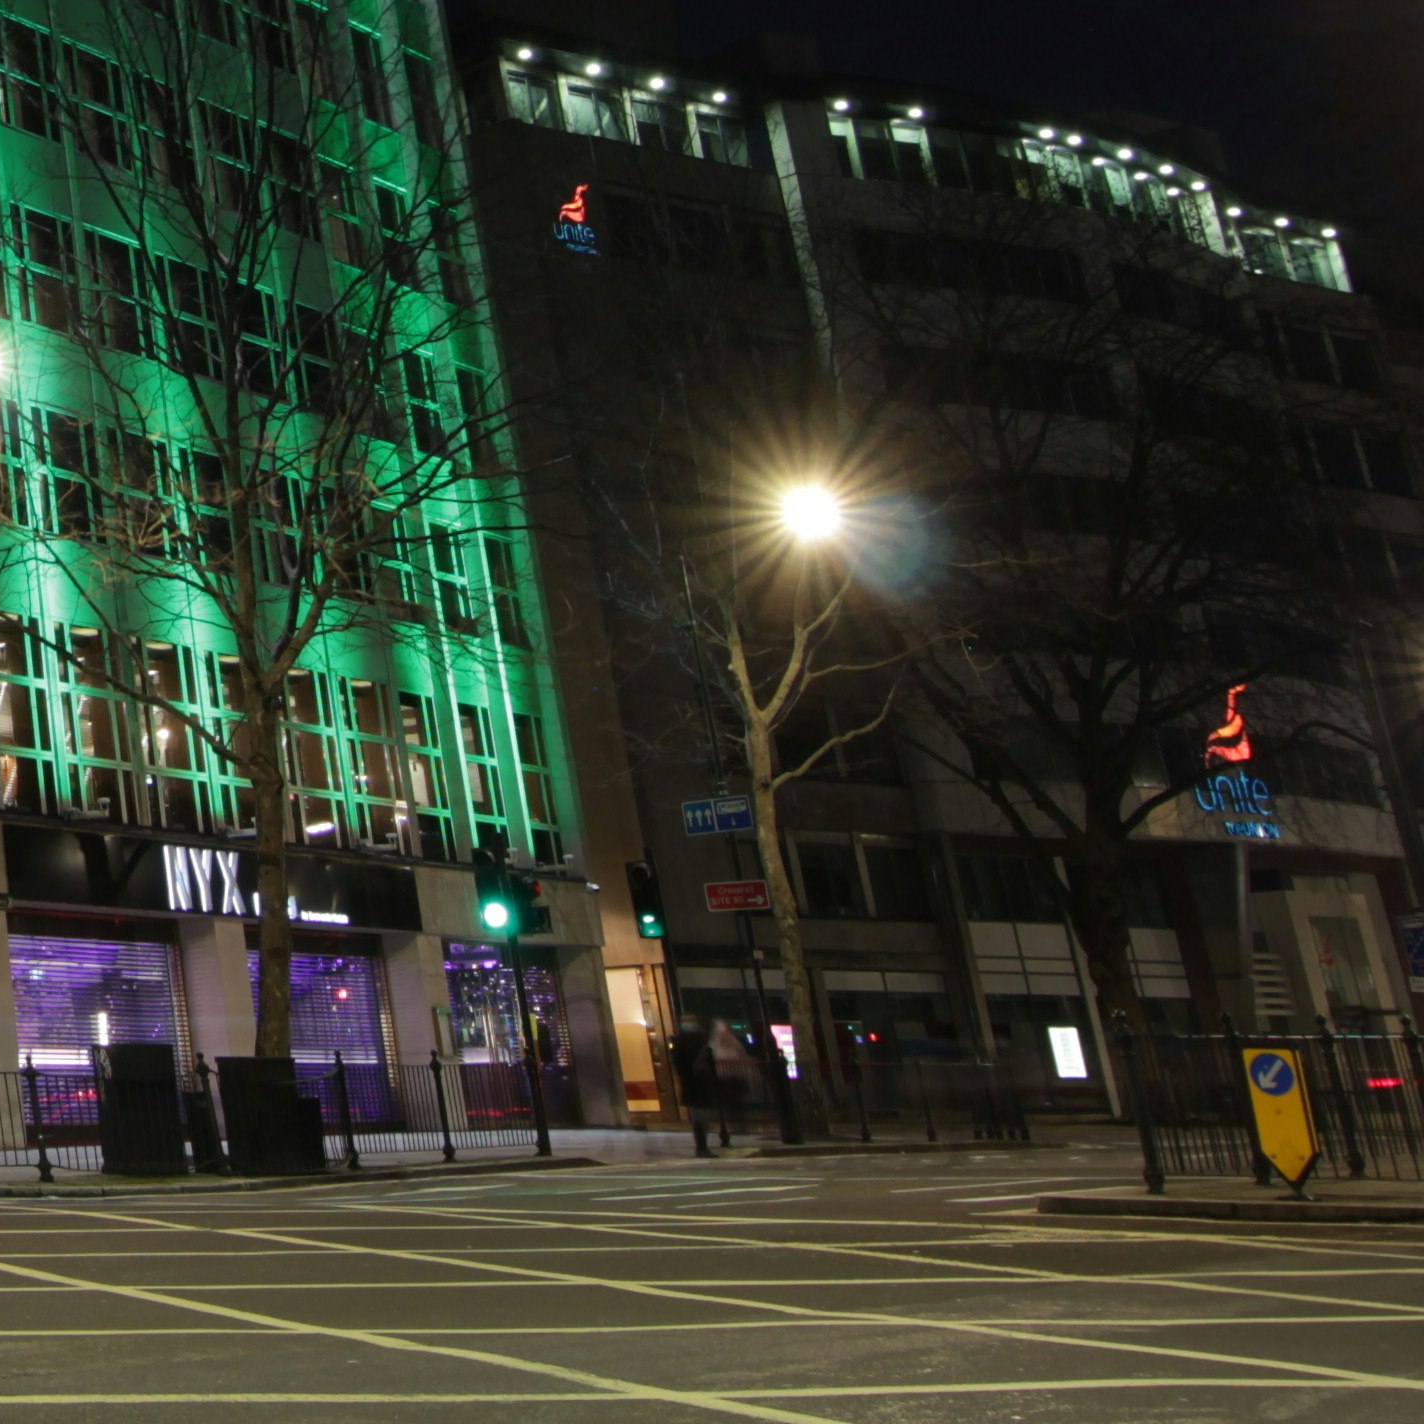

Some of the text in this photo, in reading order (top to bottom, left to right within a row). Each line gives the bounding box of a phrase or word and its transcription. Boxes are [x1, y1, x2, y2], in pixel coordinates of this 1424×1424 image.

[553, 221, 595, 244] unite
[1193, 769, 1272, 816] unite
[163, 845, 247, 915] NYX
